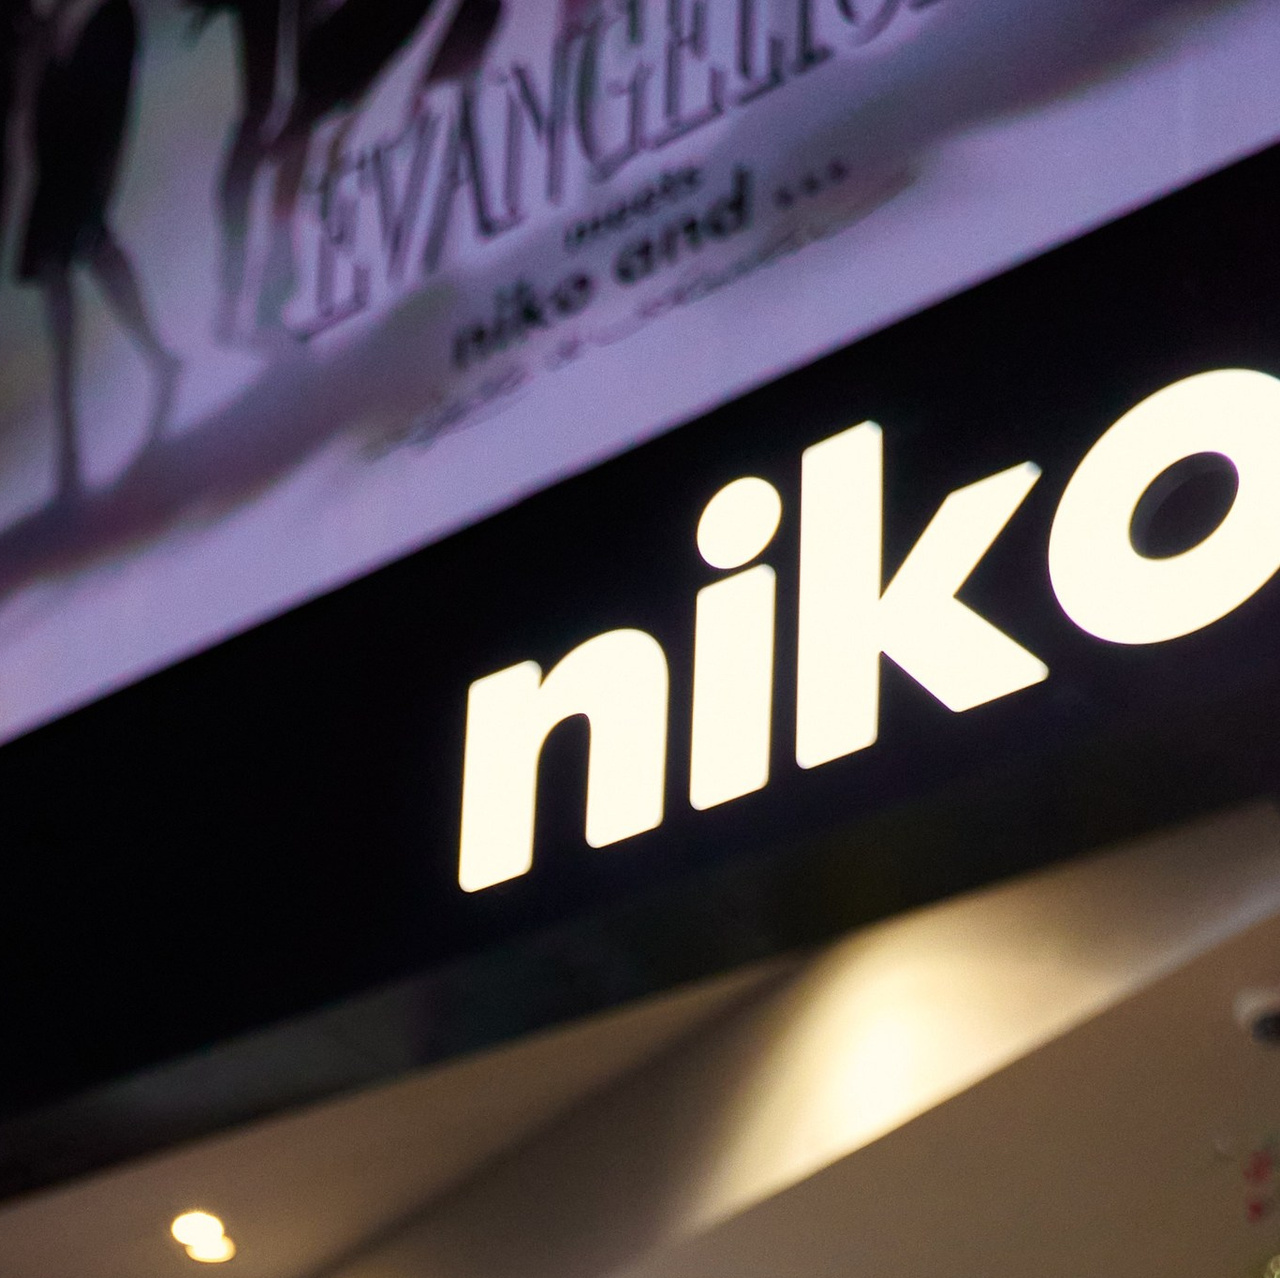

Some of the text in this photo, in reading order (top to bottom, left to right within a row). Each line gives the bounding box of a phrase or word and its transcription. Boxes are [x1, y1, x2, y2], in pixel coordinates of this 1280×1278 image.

[283, 0, 942, 342] EVANGELI
[450, 272, 594, 370] niko
[612, 163, 756, 286] and
[458, 368, 1280, 893] niko
